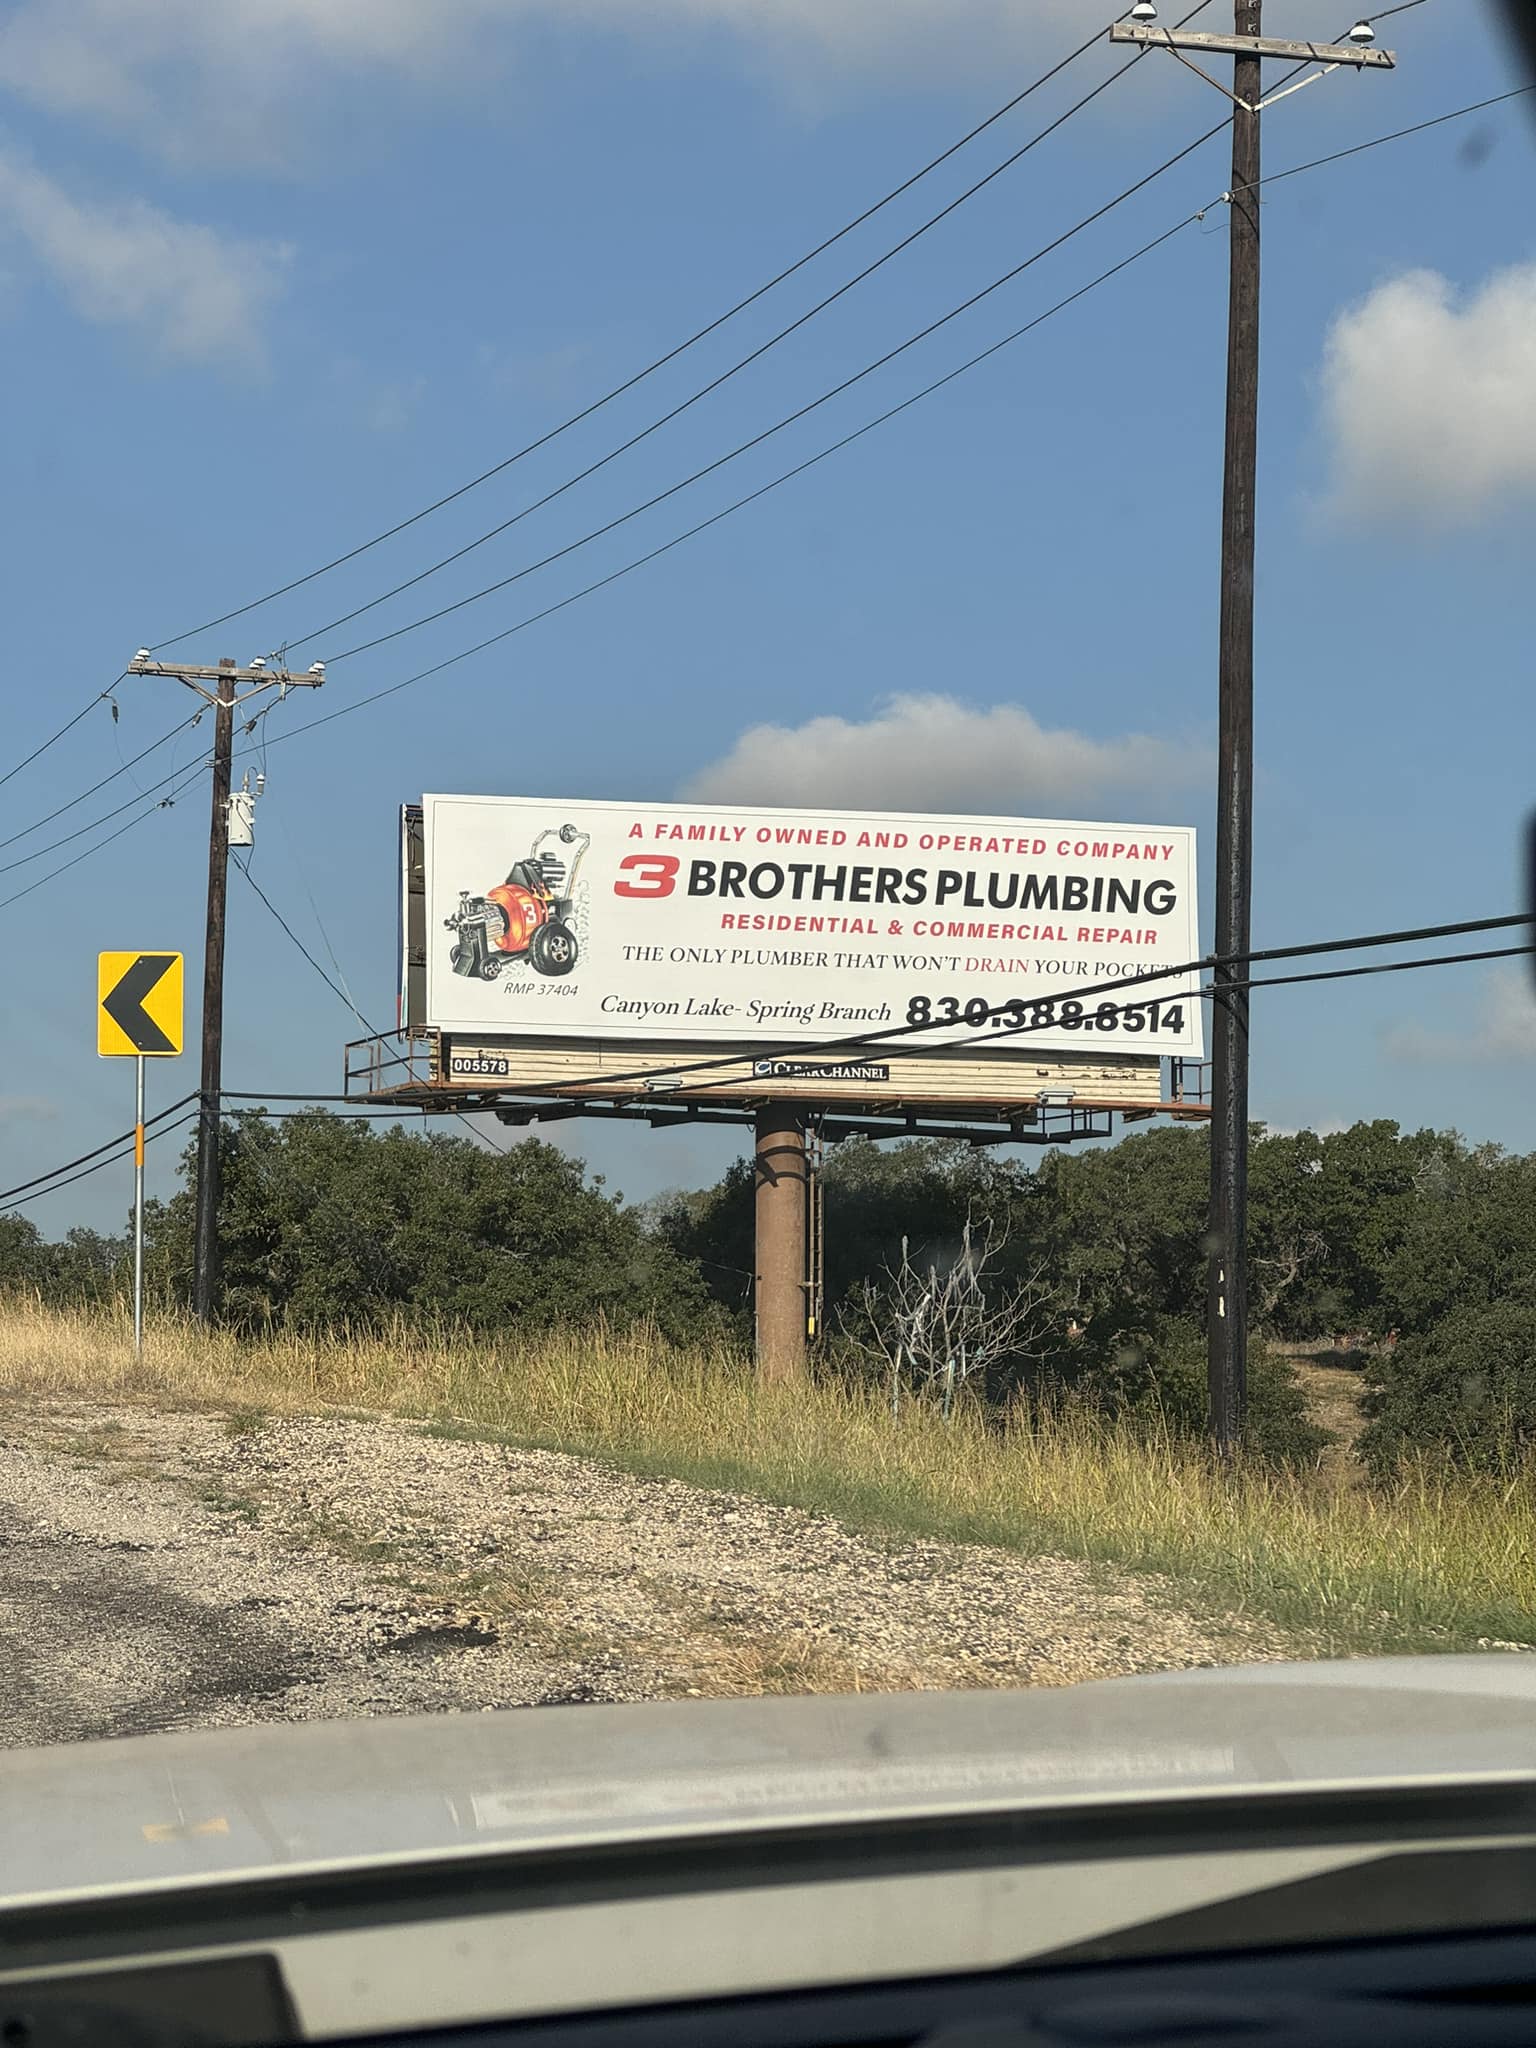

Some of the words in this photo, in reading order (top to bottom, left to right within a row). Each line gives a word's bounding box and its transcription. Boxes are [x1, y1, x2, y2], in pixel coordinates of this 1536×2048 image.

[628, 823, 643, 838] A
[654, 824, 747, 843] FAMILY
[756, 828, 847, 846] OWNED
[857, 831, 908, 849] AND
[919, 835, 1047, 855] OPERATED
[1057, 841, 1174, 861] COMPANY
[613, 855, 680, 898] 3
[688, 860, 927, 905] BROTHERS
[935, 870, 1177, 915] PLUMBING
[720, 914, 879, 935] RESIDENTIAL
[888, 920, 903, 935] &
[913, 921, 1068, 941] COMMERCIAL
[1077, 927, 1158, 944] REPAIR
[623, 946, 664, 961] THE
[670, 947, 727, 963] ONLY
[730, 950, 828, 967] PLUMBER
[834, 953, 888, 969] THAT
[965, 957, 1030, 973] DRAIN
[1035, 959, 1089, 976] YOUR
[504, 982, 535, 995] RMP
[537, 984, 579, 996] 37404
[600, 994, 680, 1024] Canyon
[684, 997, 742, 1017] Lake-
[746, 999, 815, 1025] Spring
[818, 1001, 892, 1022] Branch
[905, 995, 1185, 1034] 830.388.8514
[454, 1059, 507, 1073] 005578
